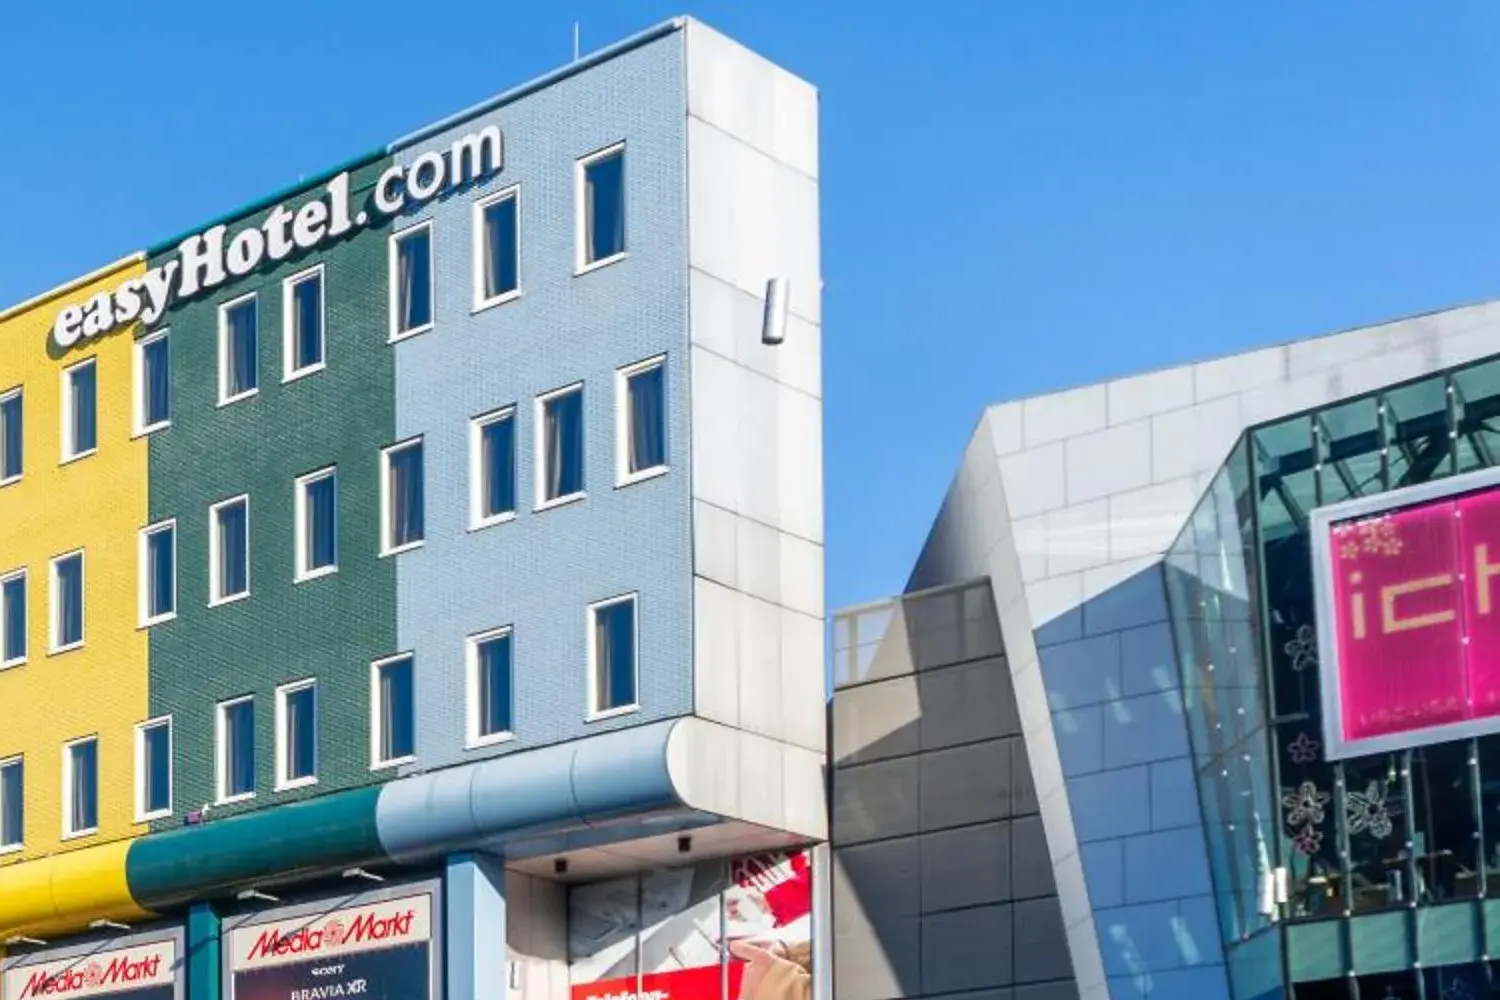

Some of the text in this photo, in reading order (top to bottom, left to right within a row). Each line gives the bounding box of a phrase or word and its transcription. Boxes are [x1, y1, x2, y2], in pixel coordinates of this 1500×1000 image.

[52, 124, 503, 349] easyHotel.com
[247, 910, 415, 960] Media Markt
[17, 954, 163, 1000] Media Markt
[311, 964, 345, 976] SONY
[346, 978, 368, 994] XR
